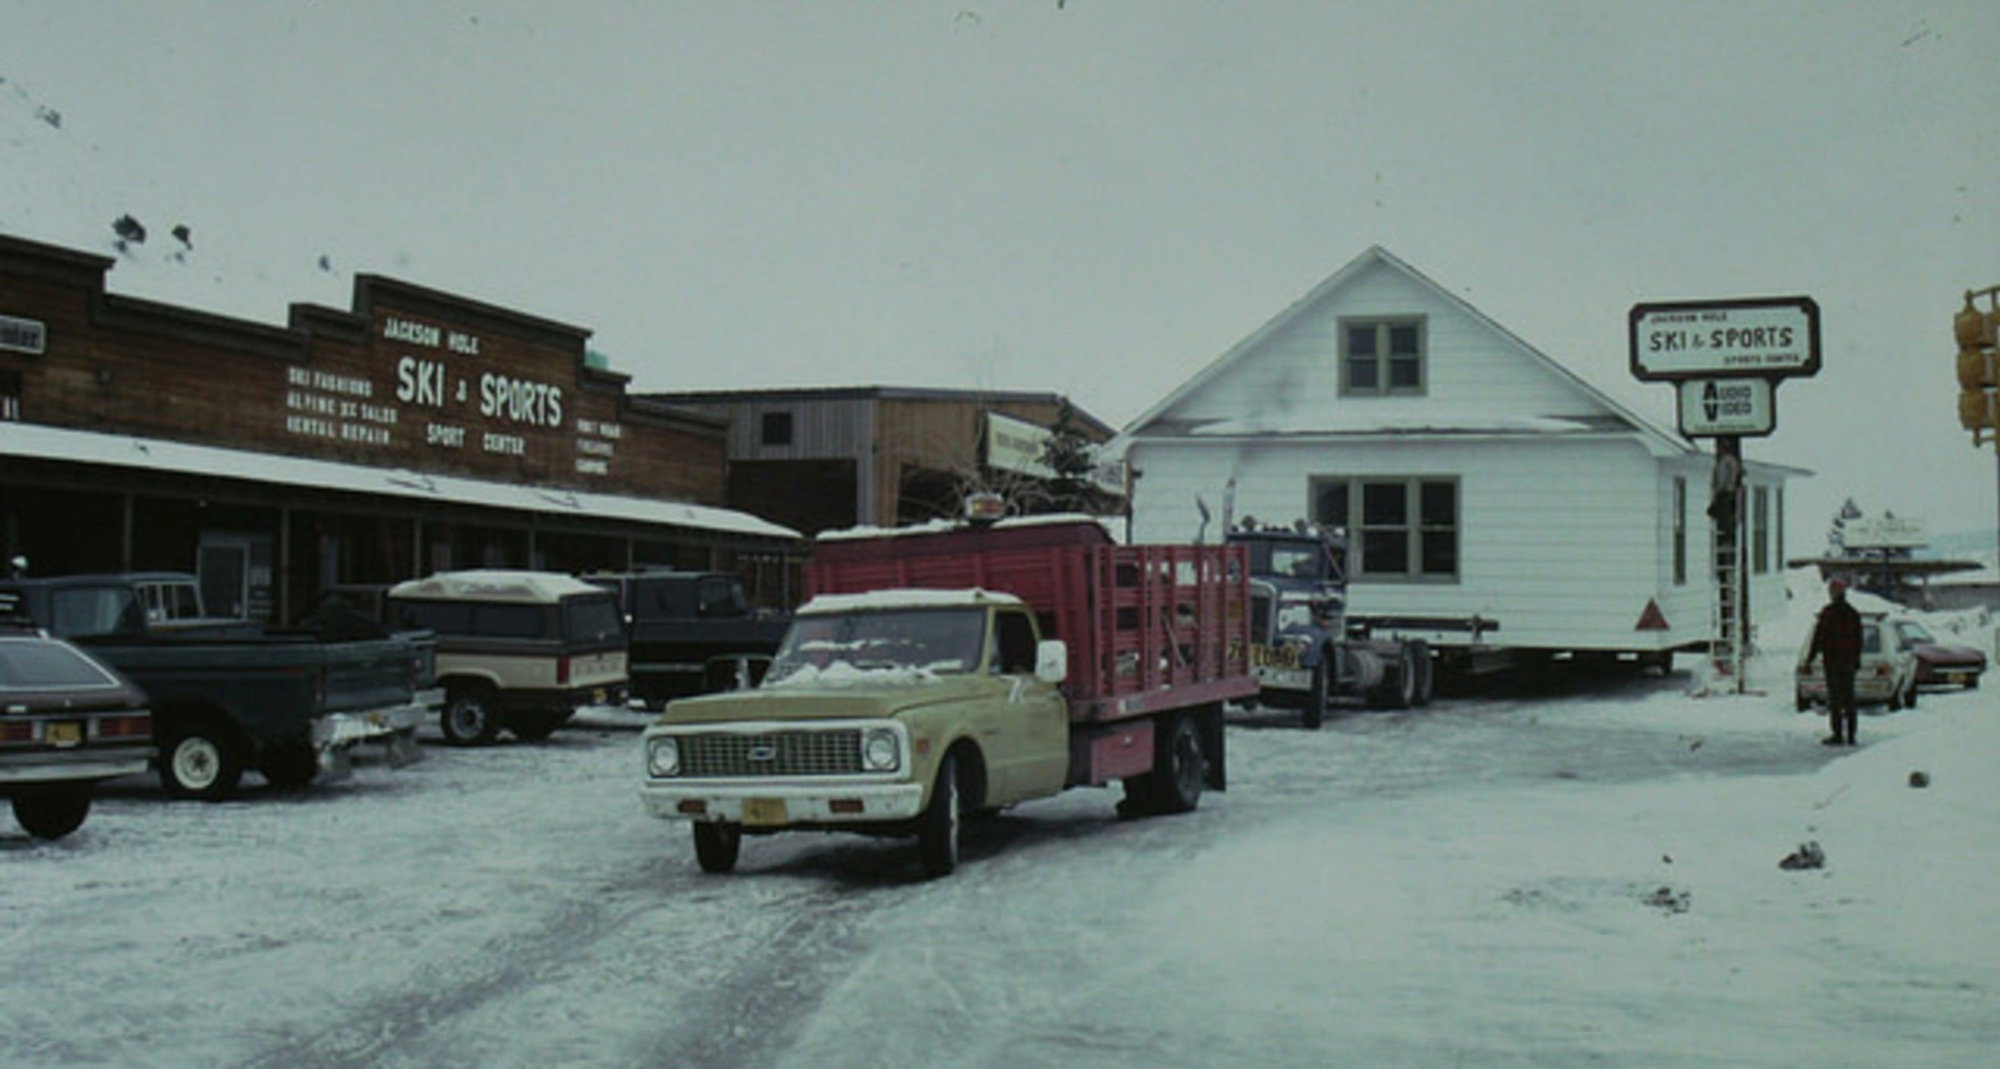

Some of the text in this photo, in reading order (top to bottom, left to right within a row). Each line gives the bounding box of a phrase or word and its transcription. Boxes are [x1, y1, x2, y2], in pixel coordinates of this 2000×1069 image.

[384, 318, 479, 355] JACKSON HOLE
[1649, 331, 1687, 352] SKI
[1710, 327, 1794, 349] SPORTS
[397, 356, 444, 407] SKI
[480, 373, 562, 427] SPORTS
[427, 424, 526, 455] SPORT CENTER
